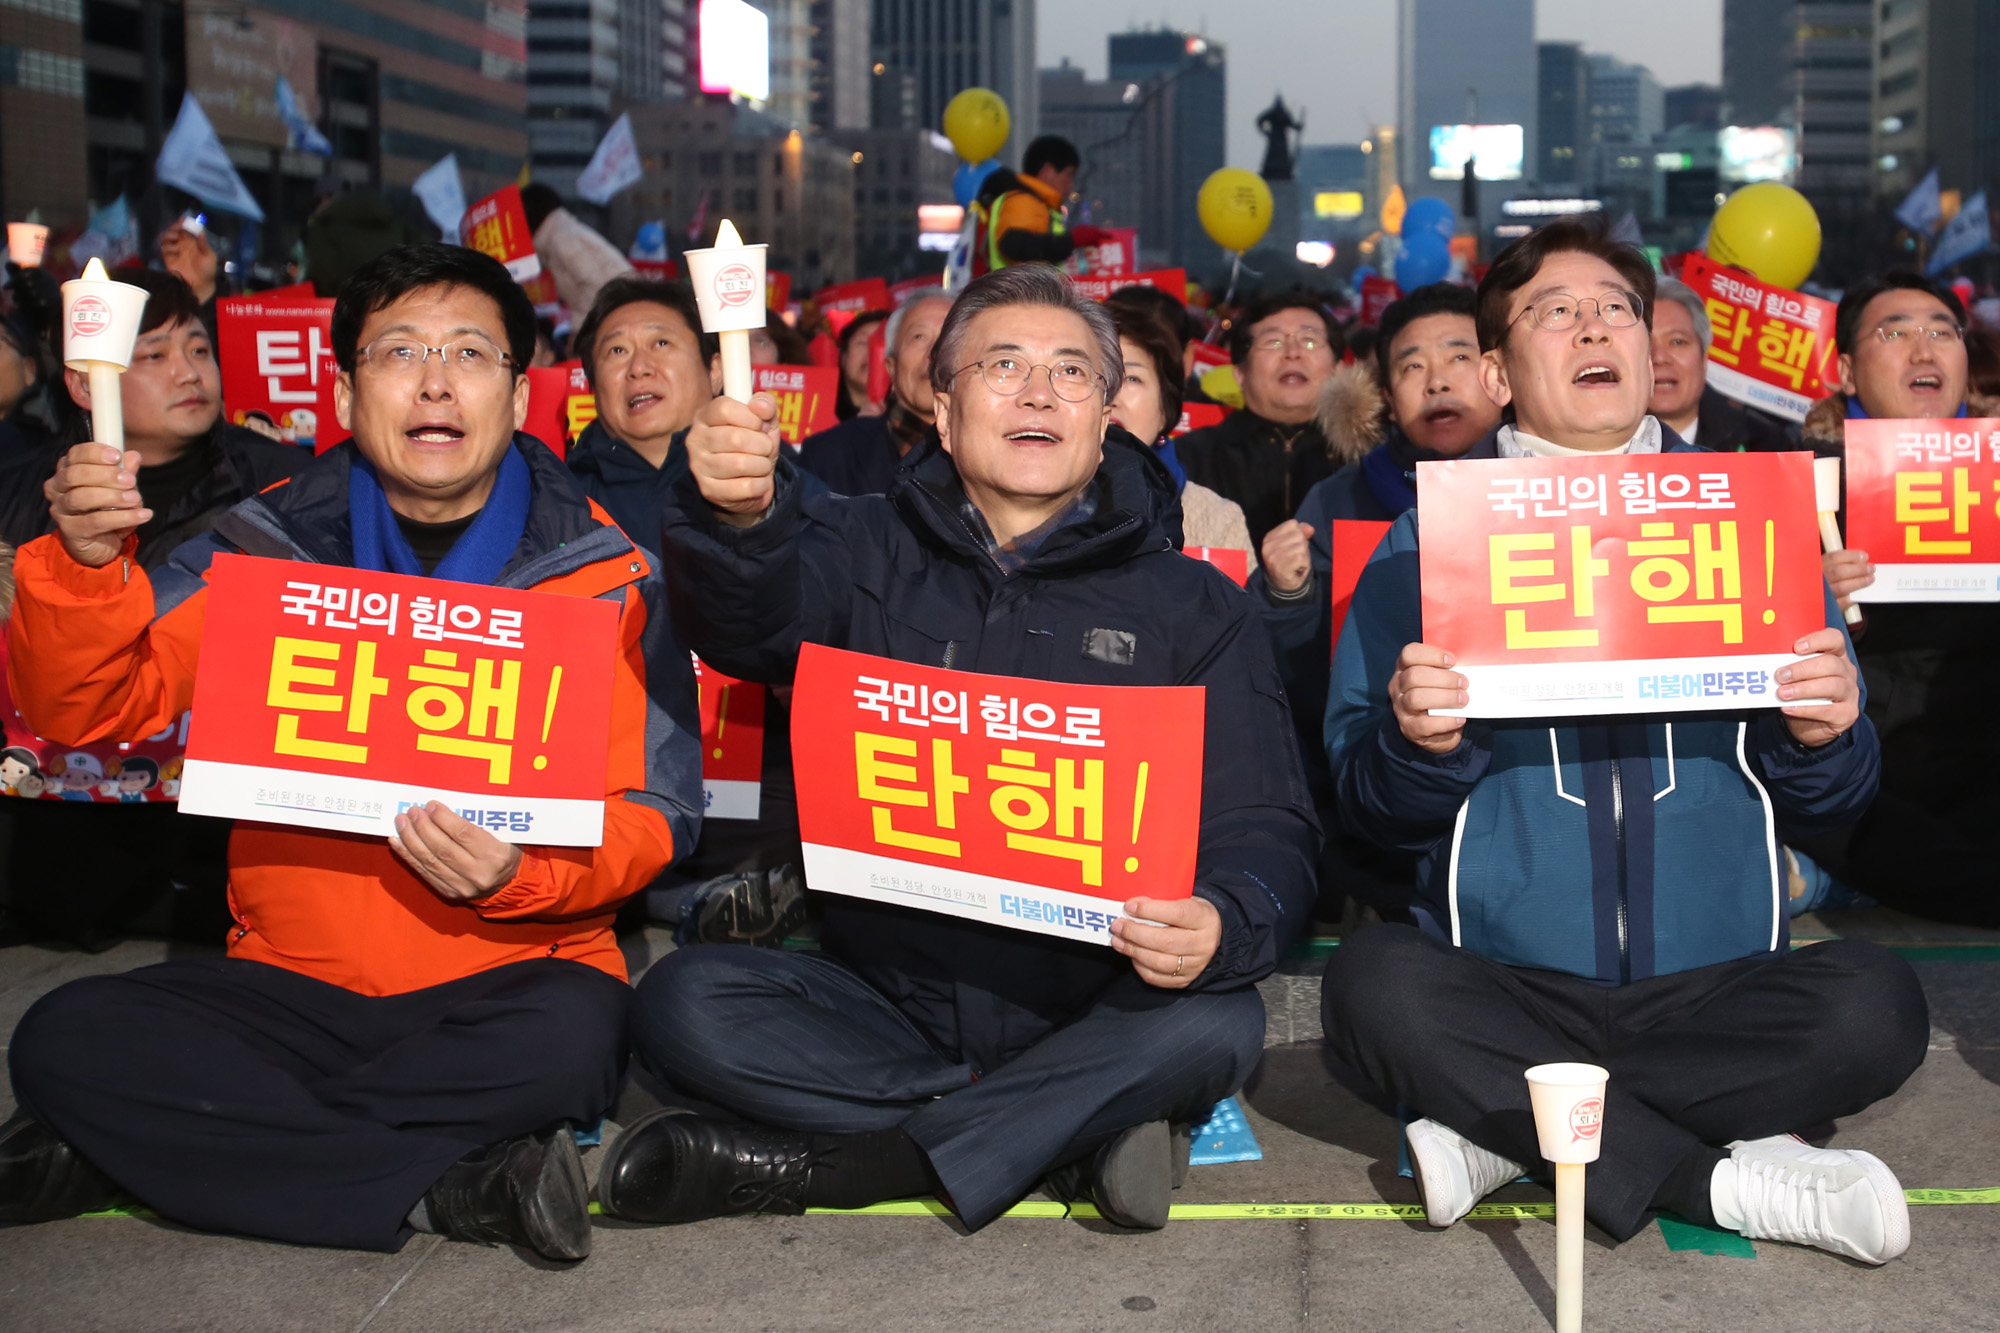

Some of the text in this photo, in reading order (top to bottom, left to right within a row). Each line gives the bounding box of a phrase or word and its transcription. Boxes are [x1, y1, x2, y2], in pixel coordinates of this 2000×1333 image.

[1712, 273, 1823, 329] 국민의 힘으로
[1706, 297, 1836, 391] 탄핵!
[1896, 431, 1981, 462] 국민의
[1487, 472, 1736, 519] 국민의 힘으로
[1896, 467, 2000, 555] 탄
[281, 581, 525, 649] 국민의 힘으로
[1489, 519, 1776, 650] 탄핵!
[266, 636, 563, 785] 탄핵!
[853, 675, 1105, 747] 국민의 힘으로
[1564, 682, 1598, 696] 안정된
[1602, 680, 1624, 694] 개혁
[1638, 671, 1769, 699] 더불어민주당
[256, 788, 291, 804] 준비된
[324, 796, 357, 812] 안정된
[361, 801, 383, 815] 개혁
[855, 731, 1149, 887] 탄핵!
[869, 873, 900, 888] 준비된
[931, 884, 963, 900] 안정된
[967, 891, 988, 905] 개혁
